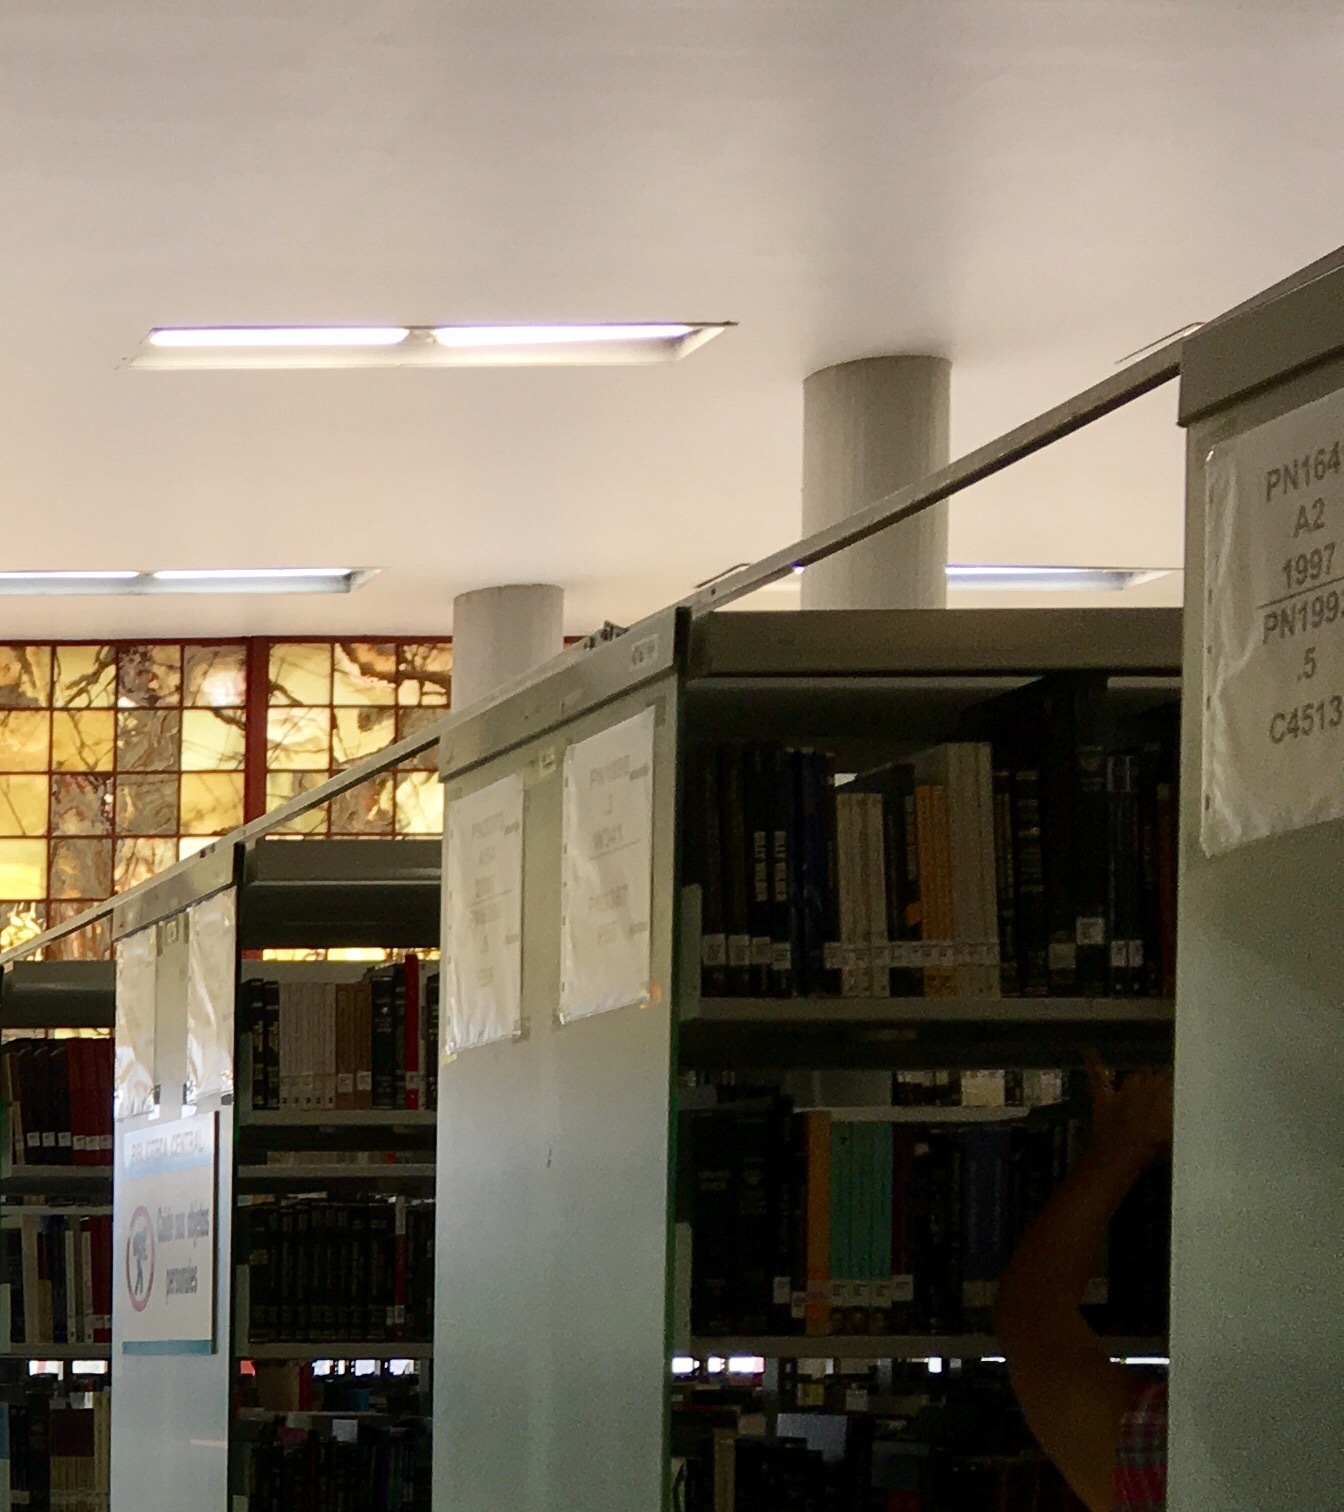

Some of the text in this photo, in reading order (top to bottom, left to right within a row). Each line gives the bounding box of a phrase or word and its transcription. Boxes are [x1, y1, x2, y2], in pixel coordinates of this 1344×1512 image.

[1292, 497, 1326, 539] A2
[1282, 541, 1337, 590] 1997
[1263, 589, 1344, 645] PN199
[1296, 646, 1317, 682] .5
[1269, 694, 1344, 745] C4513
